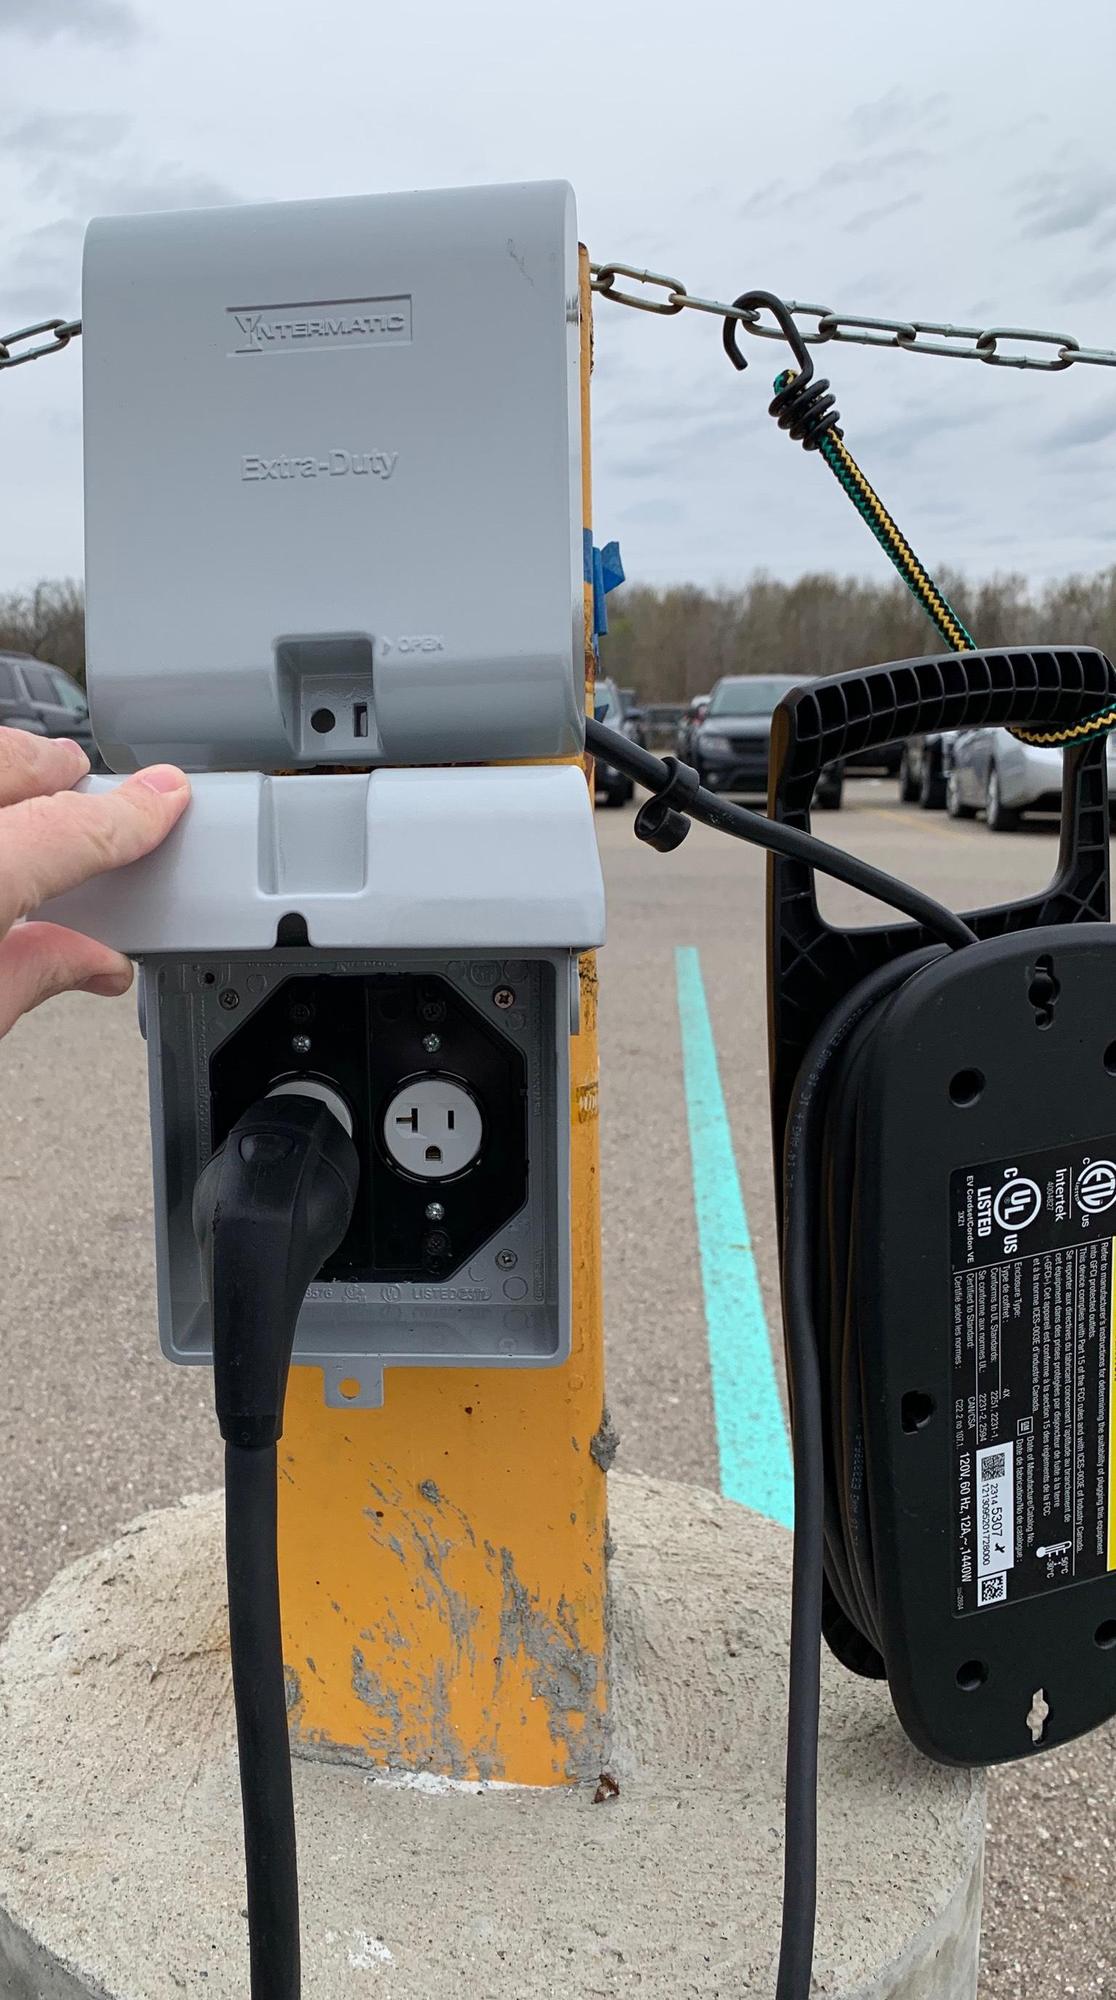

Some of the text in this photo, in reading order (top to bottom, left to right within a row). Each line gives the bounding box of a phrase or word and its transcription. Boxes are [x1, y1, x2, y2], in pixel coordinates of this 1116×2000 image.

[241, 449, 399, 481] Extra-Duty
[967, 1175, 974, 1186] EV
[1004, 1167, 1018, 1178] C
[1056, 1168, 1067, 1222] Intertek
[978, 1187, 991, 1237] LISTED
[1005, 1189, 1030, 1220] UL
[1082, 1214, 1089, 1228] US
[1004, 1234, 1018, 1254] US
[1101, 1242, 1109, 1261] Refer
[967, 1252, 974, 1263] VE
[1033, 1258, 1040, 1266] et
[1066, 1250, 1074, 1260] Se
[1079, 1247, 1087, 1263] This
[979, 1270, 986, 1280] Se
[1065, 1262, 1073, 1290] reporter
[1079, 1264, 1087, 1287] device
[1100, 1263, 1108, 1271] to
[413, 1287, 457, 1300] LISTED
[979, 1282, 987, 1316] conforme
[1001, 1265, 1010, 1318] Type de coffret
[1099, 1272, 1108, 1325] manufacturer's
[967, 1305, 974, 1313] to
[991, 1304, 998, 1312] to
[1078, 1289, 1086, 1321] complies
[991, 1313, 998, 1323] UL
[1043, 1301, 1051, 1330] appareil
[1065, 1307, 1073, 1340] directives
[1088, 1314, 1096, 1340] outlets.
[1065, 1342, 1072, 1351] du
[1099, 1327, 1107, 1367] instructions
[1078, 1356, 1085, 1365] 15
[1003, 1388, 1010, 1398] 4X
[1097, 1380, 1106, 1421] determining
[968, 1397, 976, 1429] CAN/CSA
[1043, 1420, 1050, 1429] 15
[1053, 1411, 1061, 1448] disjoncteur
[1077, 1422, 1085, 1435] and
[1016, 1439, 1024, 1456] Date
[1063, 1425, 1072, 1457] l'aptitude
[1077, 1436, 1085, 1451] with
[1054, 1450, 1061, 1459] de
[1097, 1435, 1105, 1466] suitability
[959, 1452, 970, 1480] 120V,
[1016, 1457, 1023, 1465] de
[1064, 1458, 1071, 1467] au
[960, 1481, 970, 1494] 60
[1043, 1484, 1050, 1493] de
[1064, 1468, 1072, 1513] branchement
[1096, 1477, 1104, 1505] plugging
[959, 1497, 970, 1513] Hz,
[1076, 1498, 1084, 1525] Industry
[982, 1483, 990, 1565] 1213095201728000
[992, 1507, 1002, 1536] 5307
[1017, 1516, 1023, 1524] de
[1064, 1514, 1072, 1522] de
[1015, 1526, 1024, 1558] catalogue
